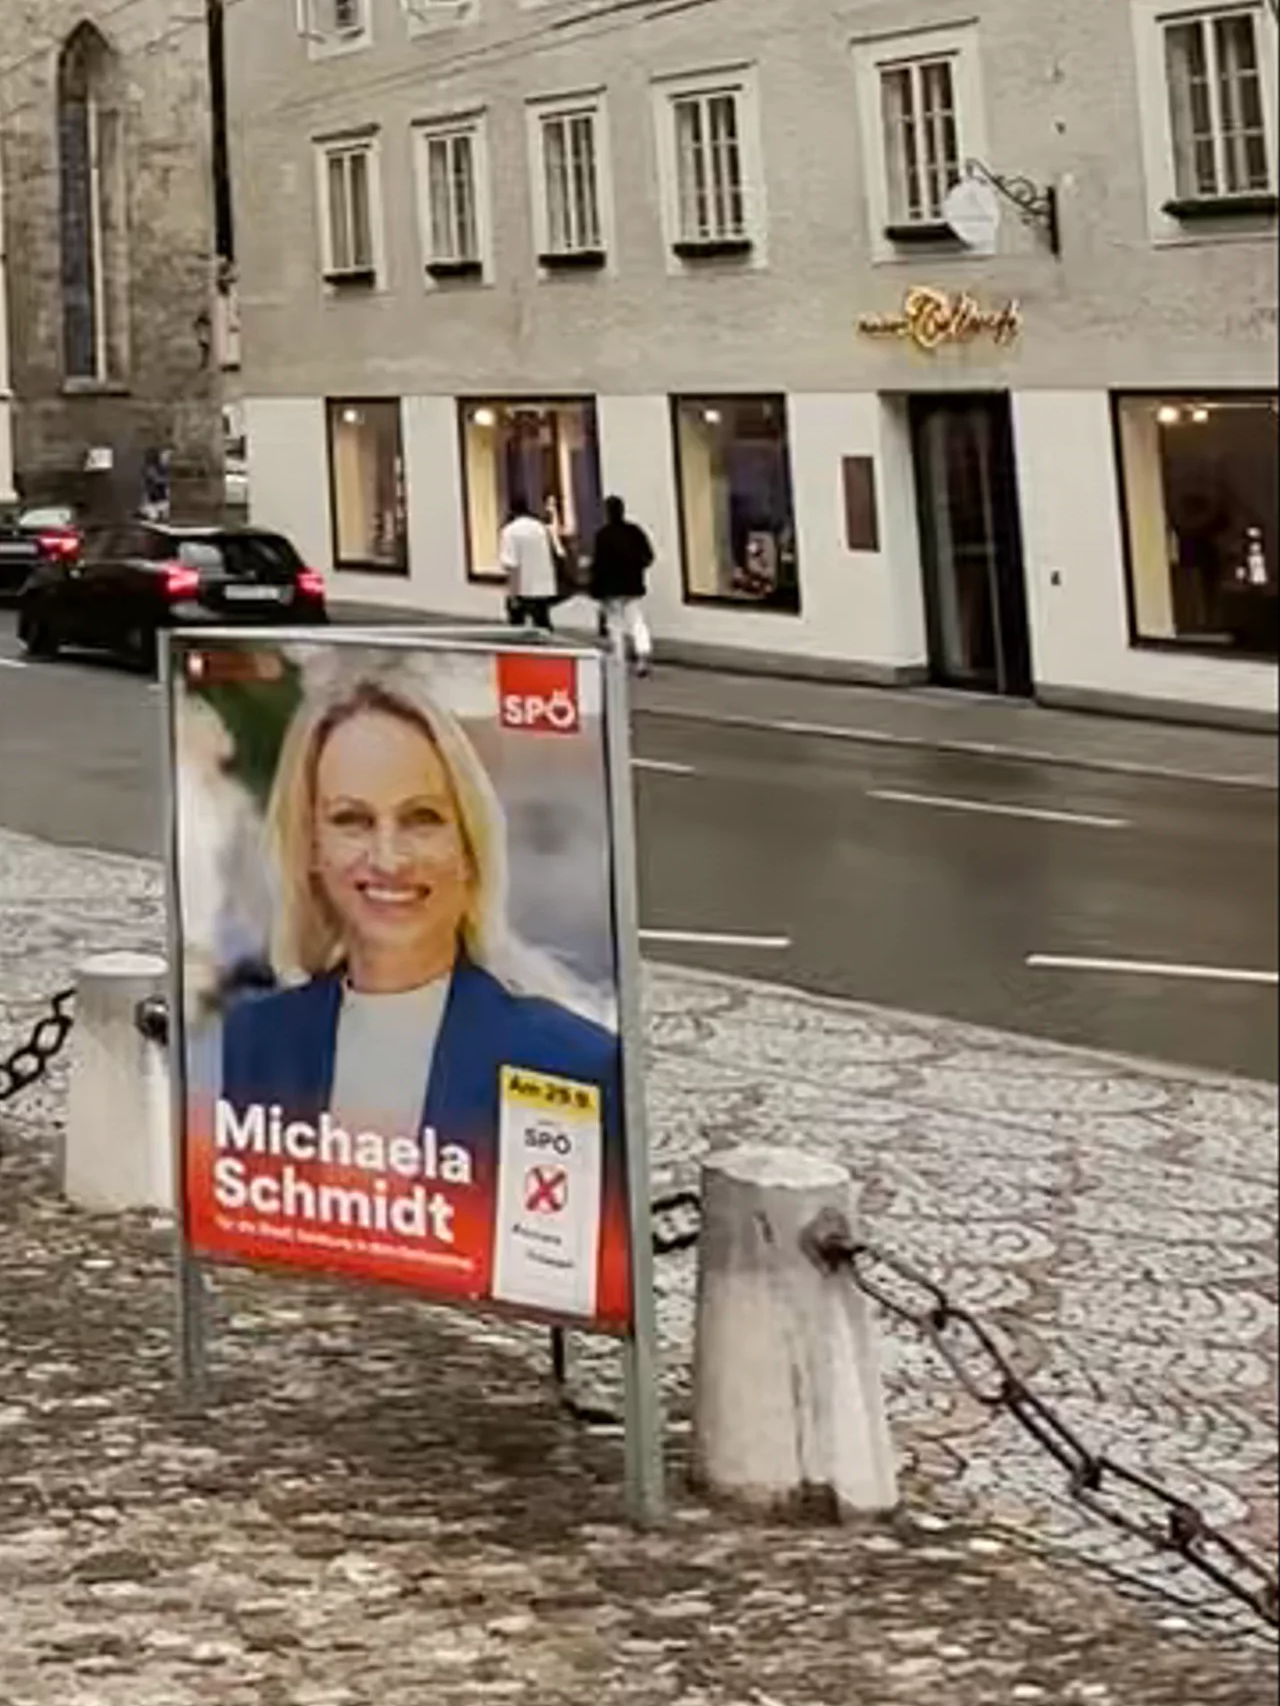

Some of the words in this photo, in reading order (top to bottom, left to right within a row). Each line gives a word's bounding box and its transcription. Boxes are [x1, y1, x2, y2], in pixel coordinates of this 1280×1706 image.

[502, 689, 576, 727] SPÖ
[214, 1099, 472, 1184] Michaela
[213, 1156, 455, 1244] Schmidt
